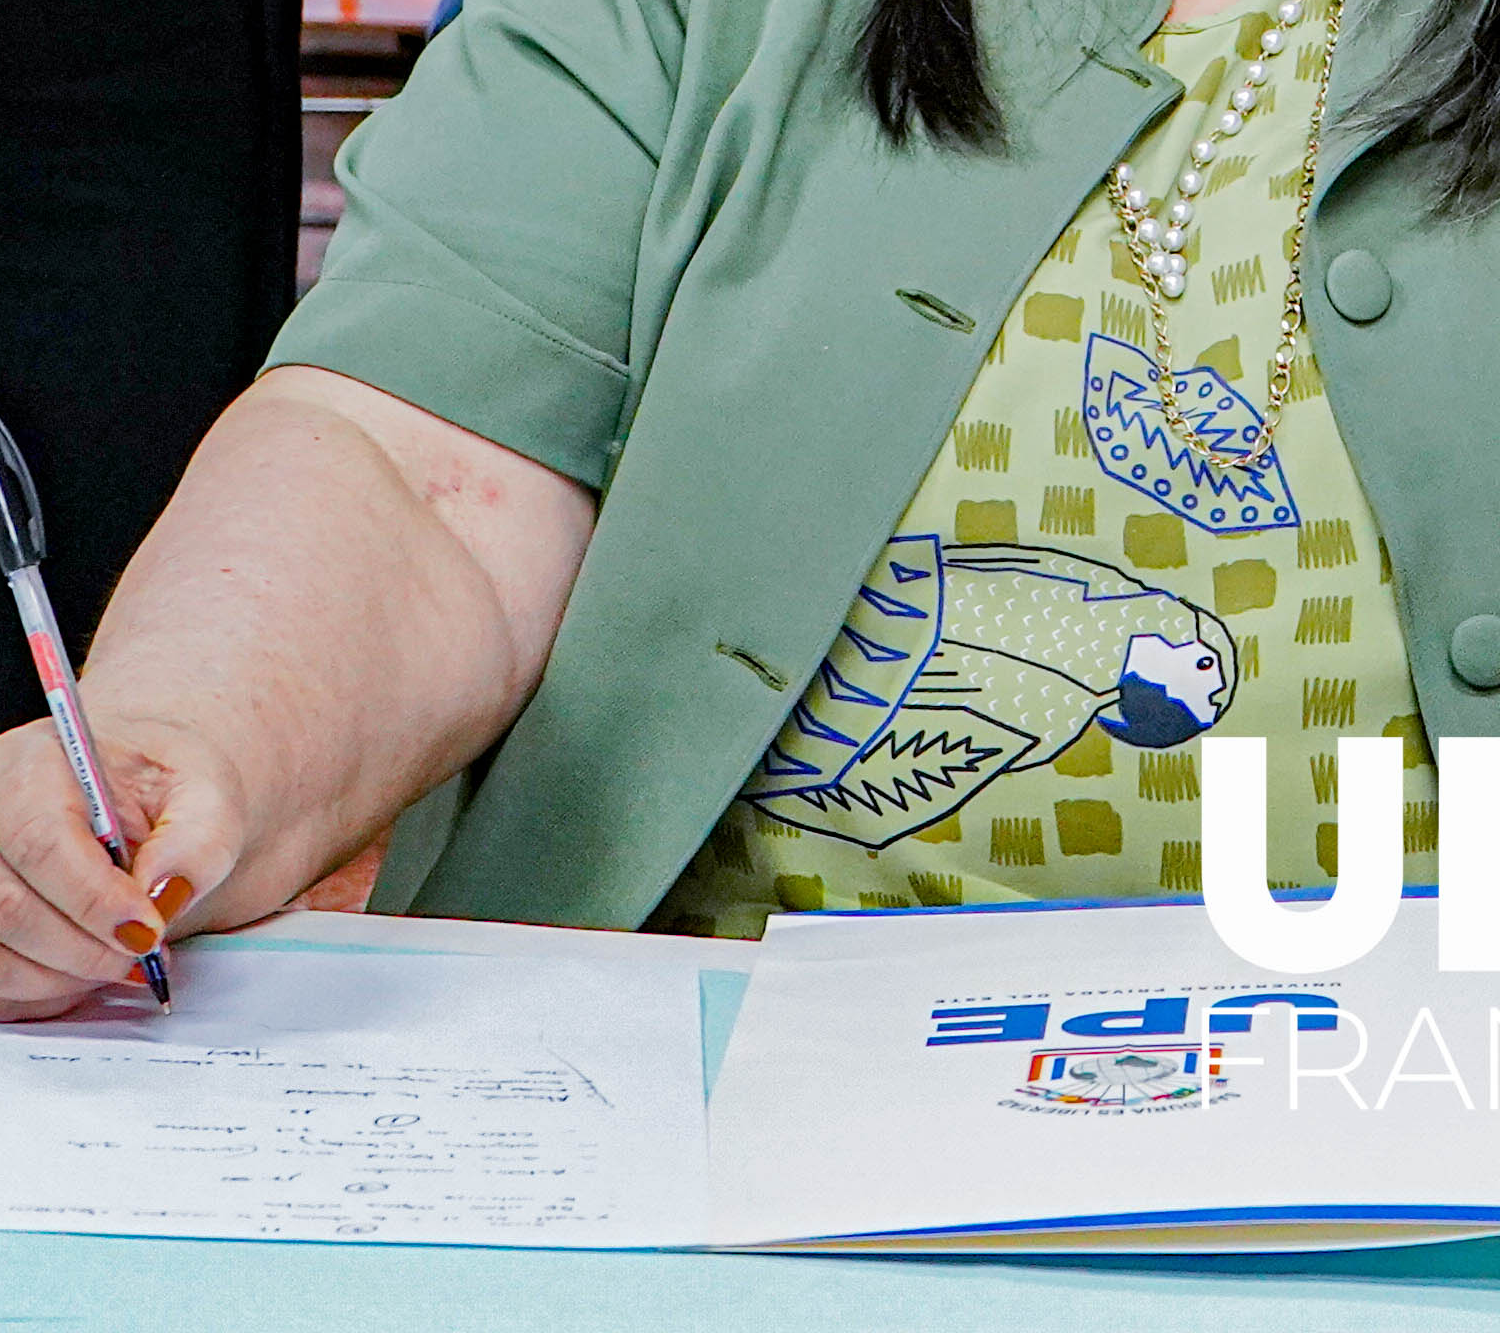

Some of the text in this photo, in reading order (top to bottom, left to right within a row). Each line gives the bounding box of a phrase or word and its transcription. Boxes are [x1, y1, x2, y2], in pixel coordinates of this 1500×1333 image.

[1065, 988, 1165, 997] PRIVADA
[1181, 982, 1341, 992] UNIVERSIDAD
[926, 993, 1339, 1047] UPE
[997, 1099, 1090, 1116] LIBERTAD
